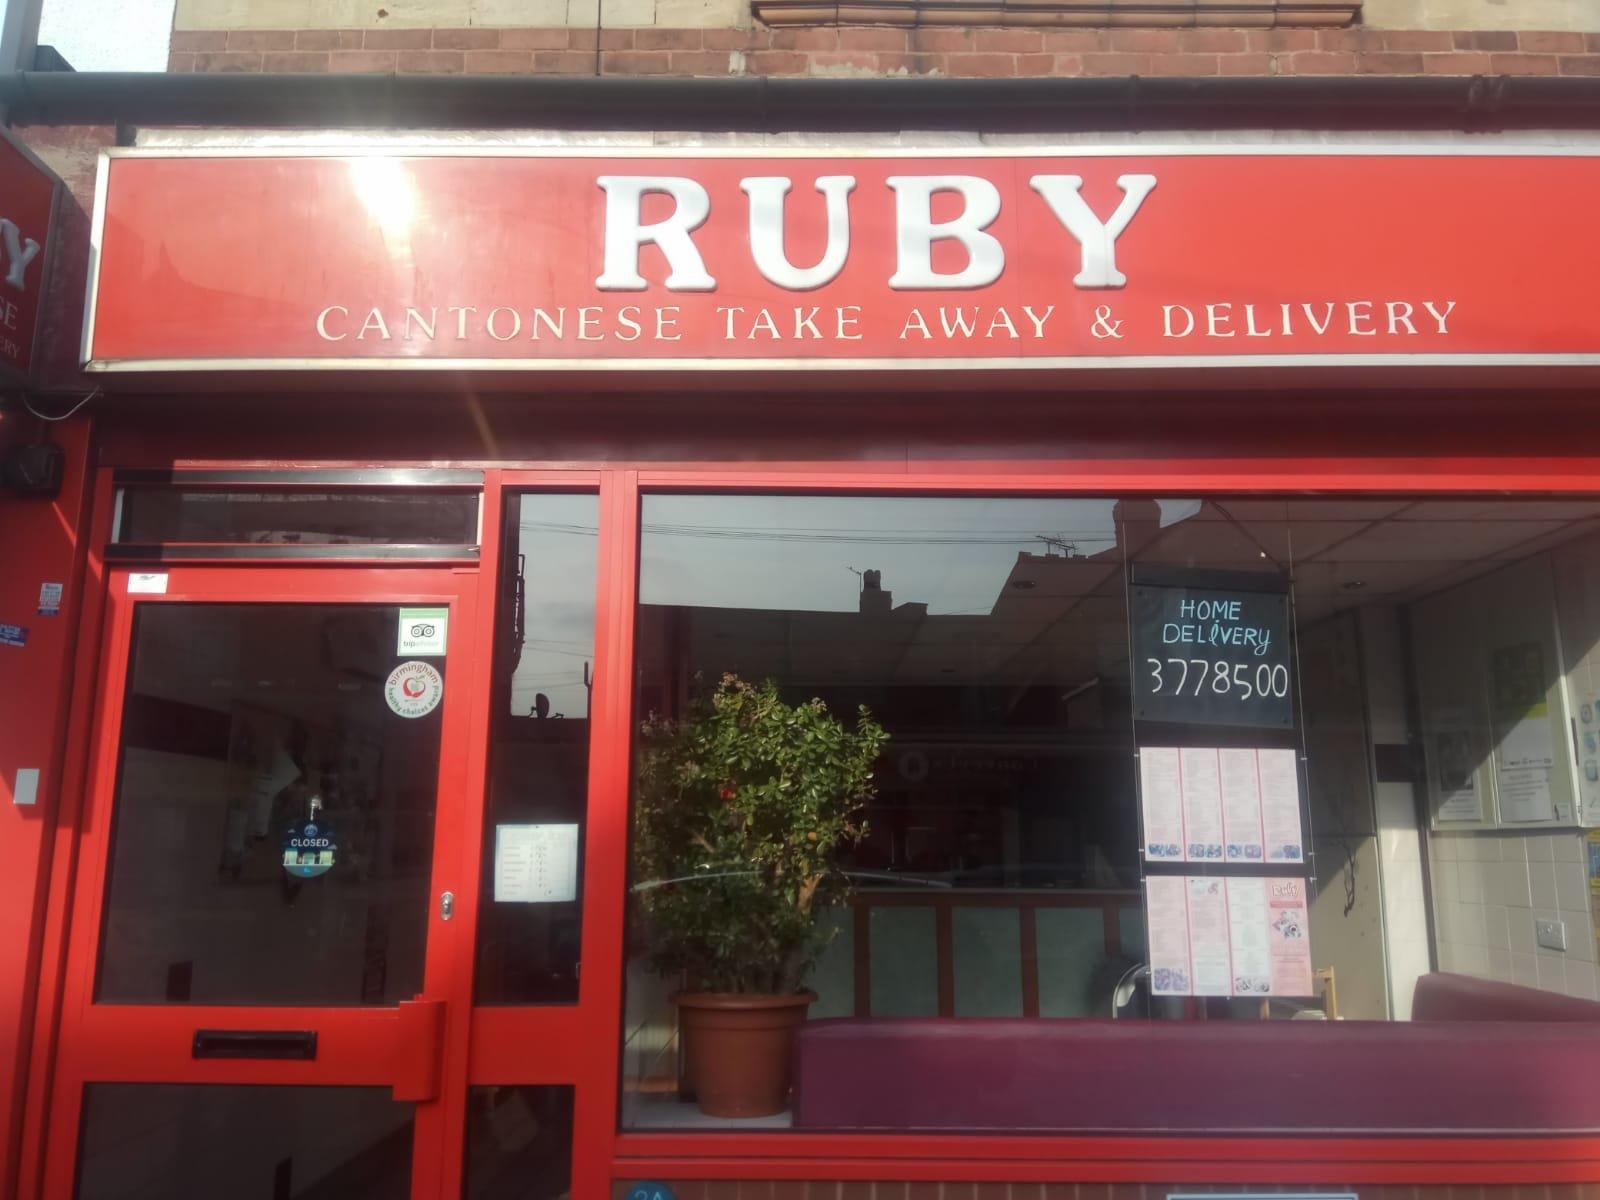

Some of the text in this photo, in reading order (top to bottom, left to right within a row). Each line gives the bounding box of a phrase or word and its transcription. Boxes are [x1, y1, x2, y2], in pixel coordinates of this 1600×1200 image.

[595, 173, 1158, 293] RUBY
[316, 301, 1457, 342] CANTONESE TAKE AWAY & DELIVERY
[1180, 599, 1242, 621] HOME
[389, 663, 439, 686] birmingham
[1147, 658, 1288, 700] 3778500
[290, 838, 329, 847] CLOSED
